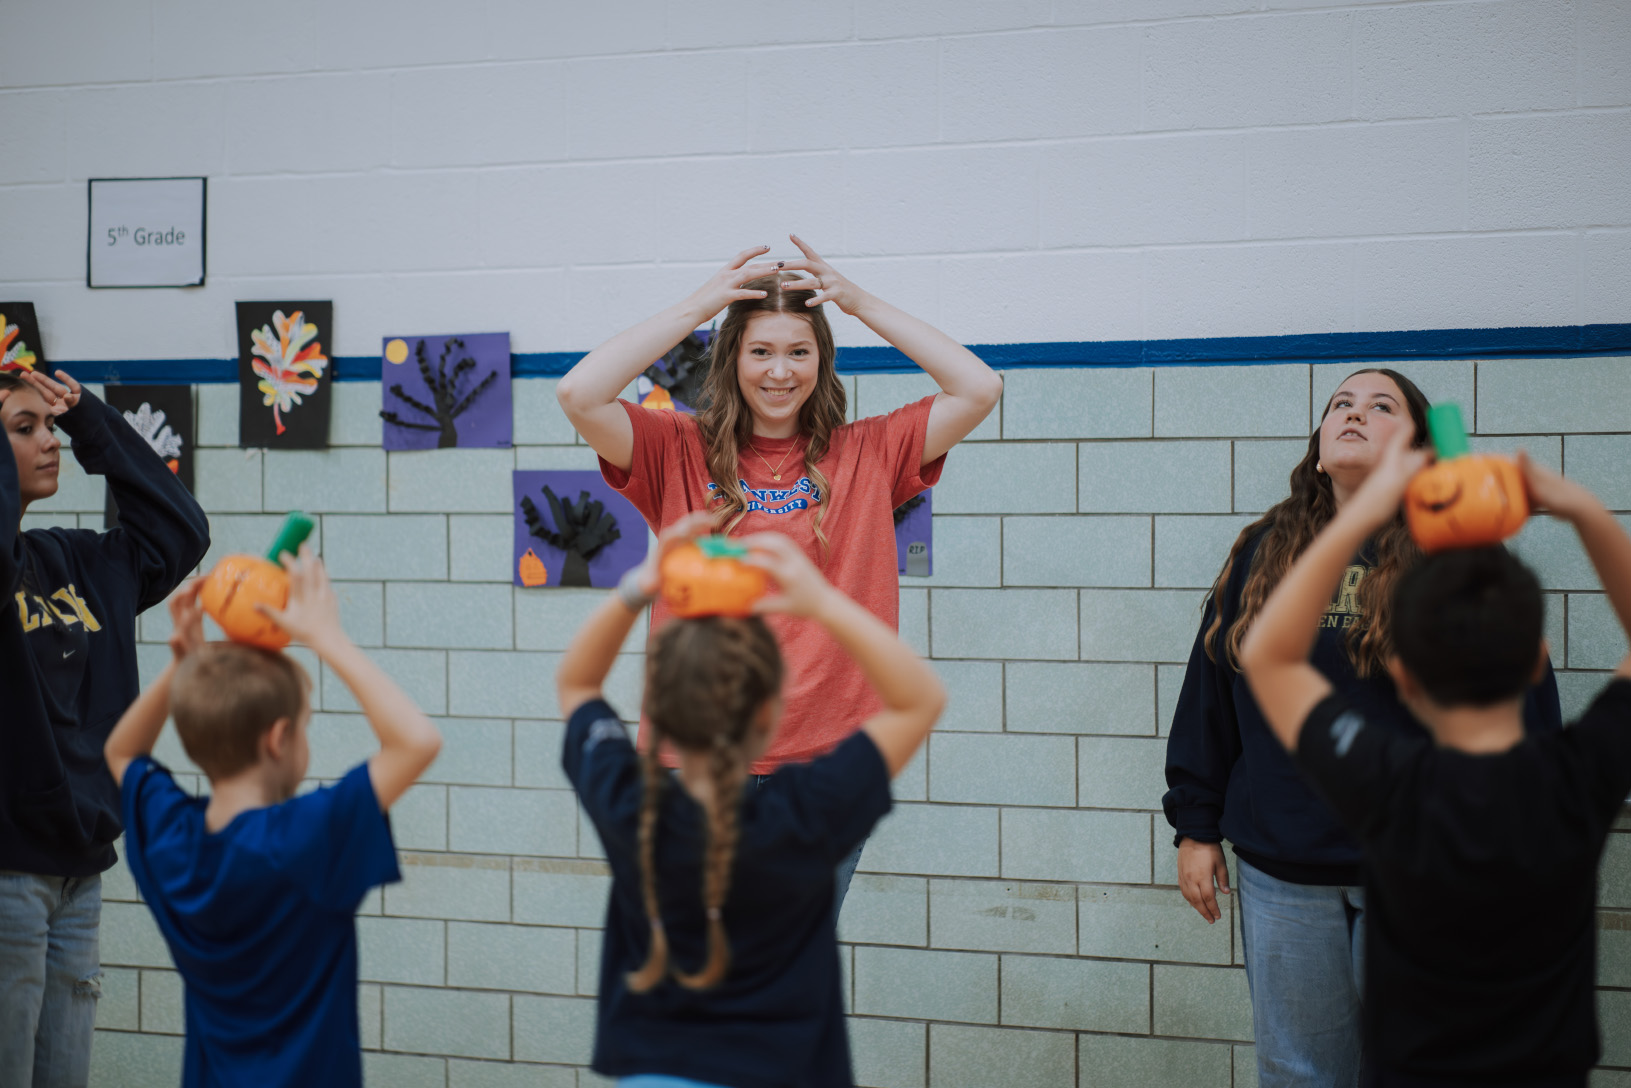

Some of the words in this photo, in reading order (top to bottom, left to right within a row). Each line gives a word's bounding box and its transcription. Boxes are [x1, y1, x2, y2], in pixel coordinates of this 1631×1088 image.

[107, 225, 128, 246] 5th
[134, 226, 185, 246] Grade
[738, 500, 802, 514] NIVERSITY
[909, 545, 926, 554] RIP
